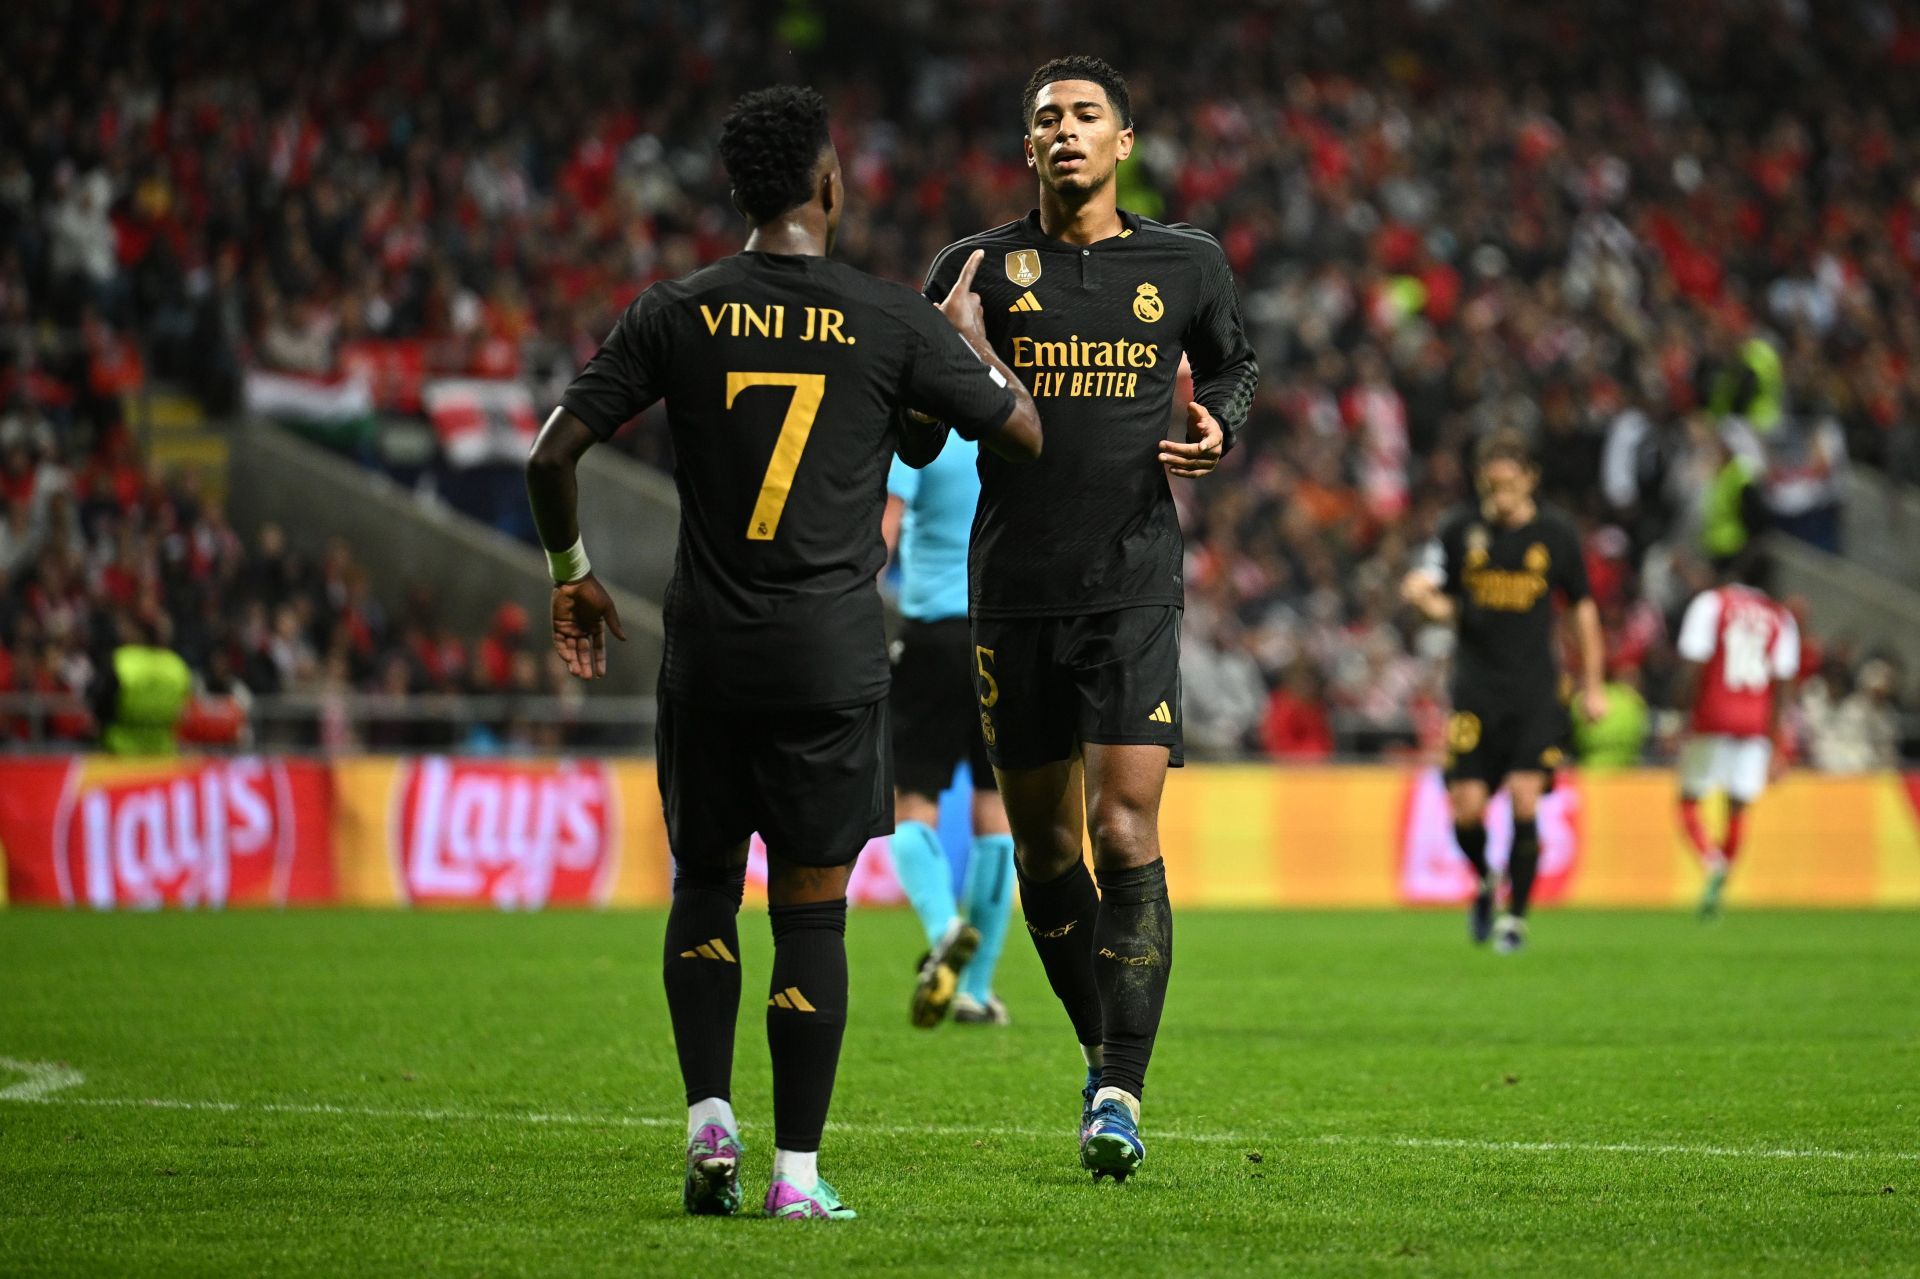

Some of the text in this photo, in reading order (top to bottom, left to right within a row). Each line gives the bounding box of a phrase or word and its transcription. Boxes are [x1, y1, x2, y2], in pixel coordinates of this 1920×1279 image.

[700, 303, 856, 345] VINI JR.
[1012, 334, 1158, 369] Emirates
[1033, 371, 1138, 398] FLY BETTER
[726, 372, 826, 541] 7
[976, 645, 999, 708] 5
